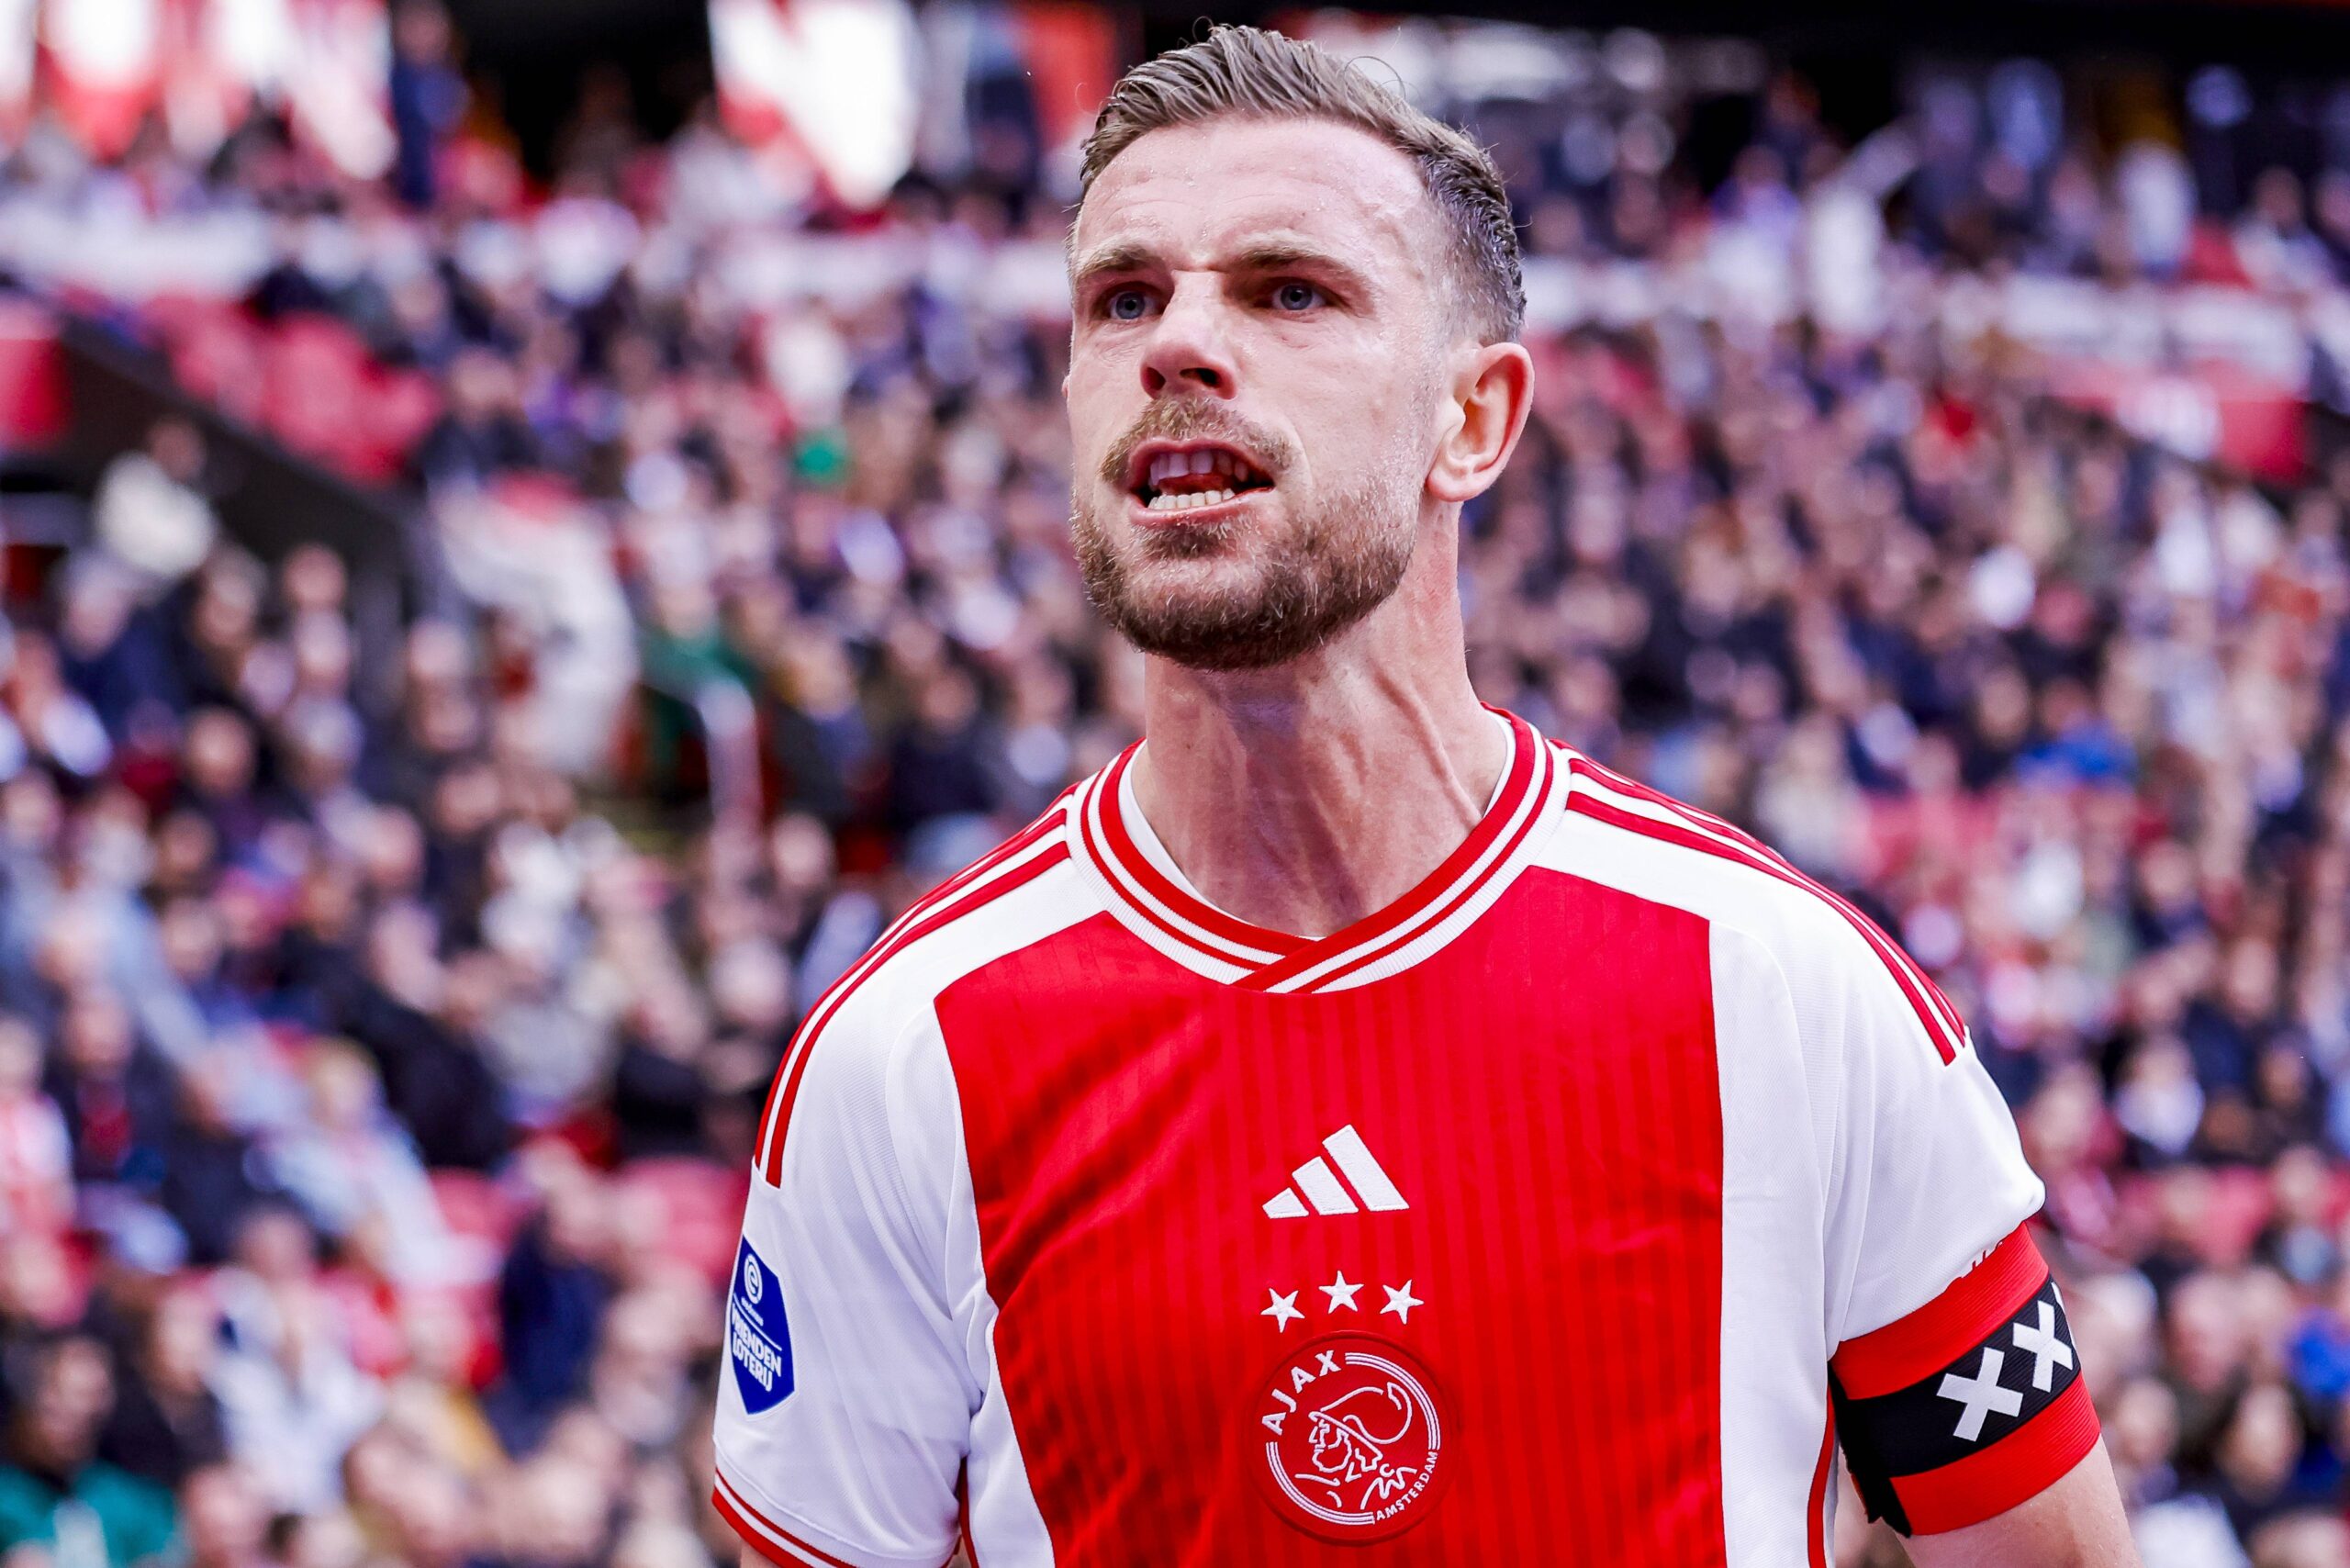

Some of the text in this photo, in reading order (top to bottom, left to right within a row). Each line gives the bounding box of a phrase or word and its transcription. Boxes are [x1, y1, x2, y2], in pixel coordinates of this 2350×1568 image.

[732, 1303, 782, 1377] VRIENDEN
[733, 1331, 773, 1392] LOTERIJ
[1261, 1350, 1341, 1436] AJAX
[1376, 1451, 1438, 1521] AMSTERDAM
